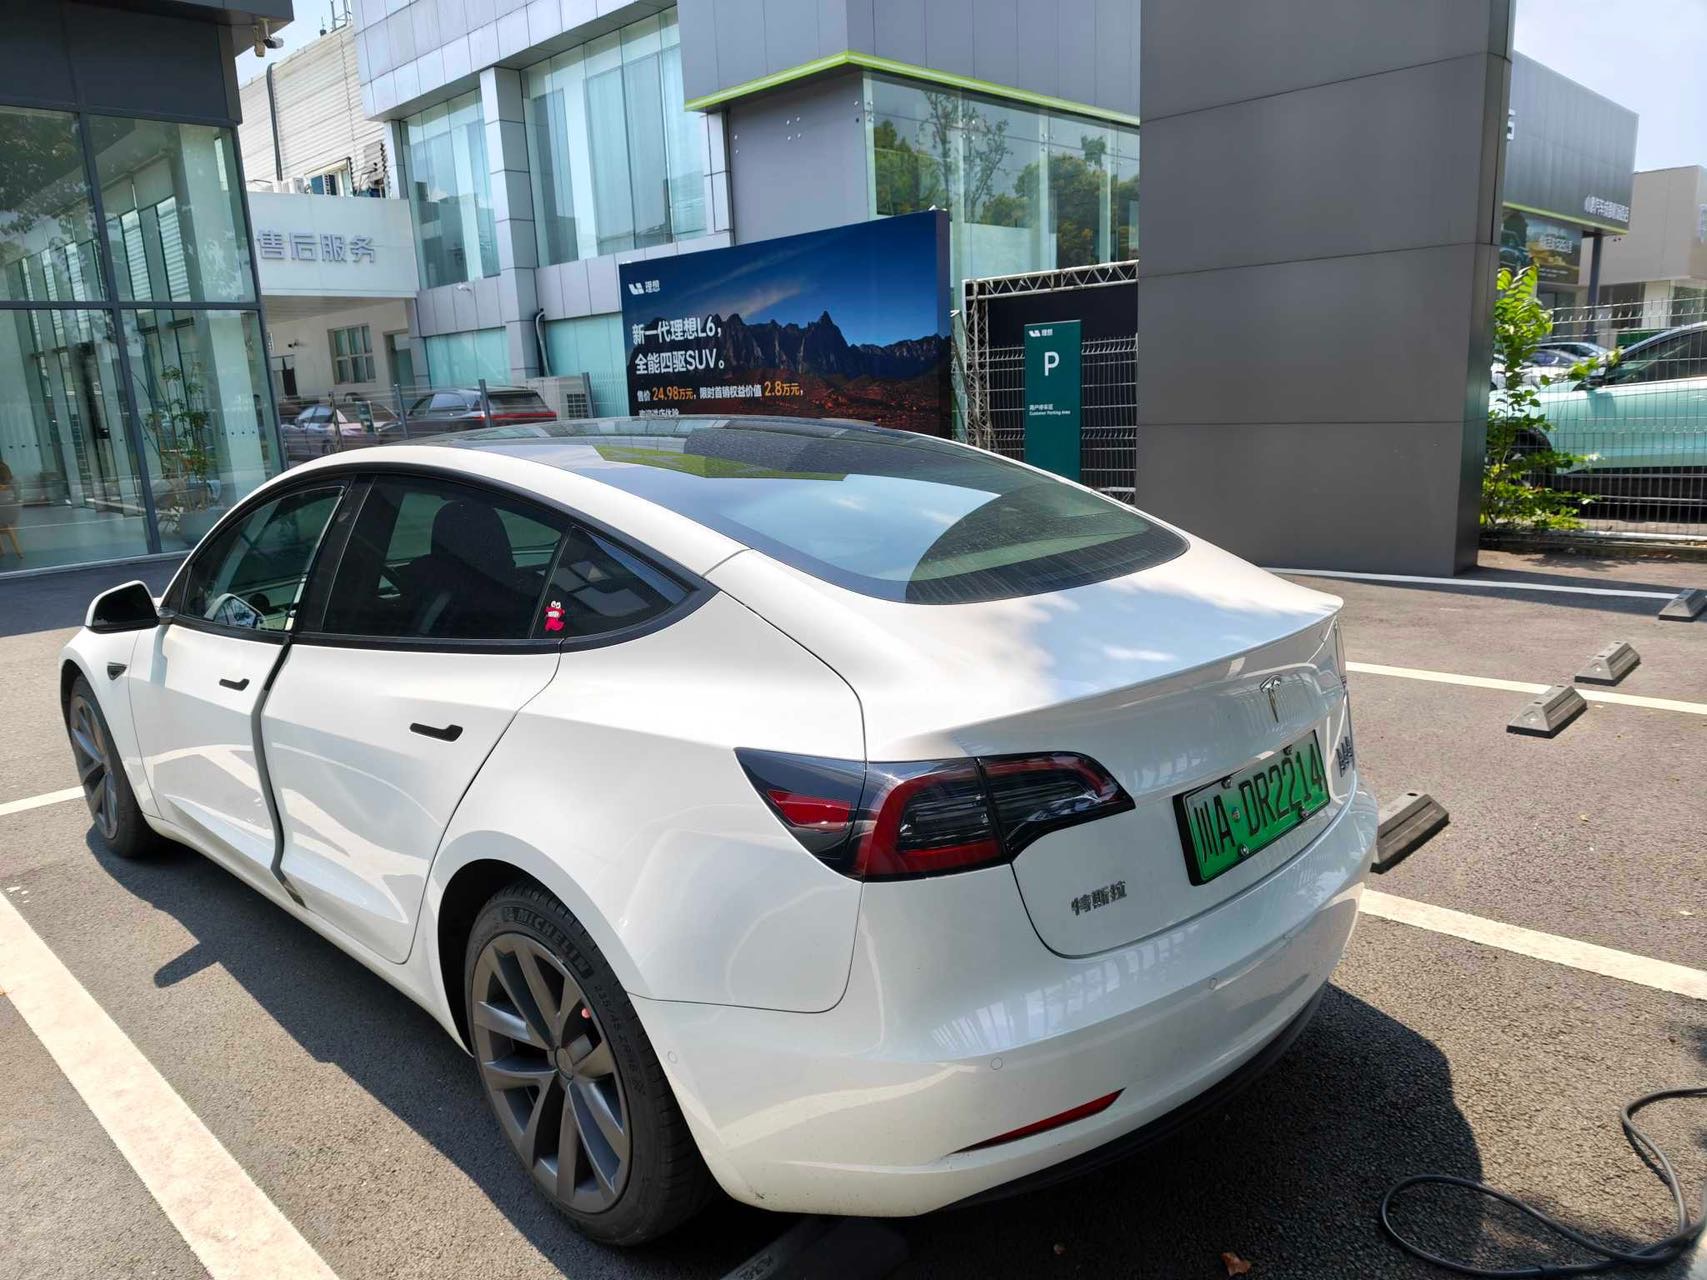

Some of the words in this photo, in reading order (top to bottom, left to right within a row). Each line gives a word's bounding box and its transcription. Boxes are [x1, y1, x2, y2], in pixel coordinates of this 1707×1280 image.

[257, 229, 376, 263] 售后服务
[1044, 351, 1060, 376] P
[1071, 880, 1127, 916] 特斯拉
